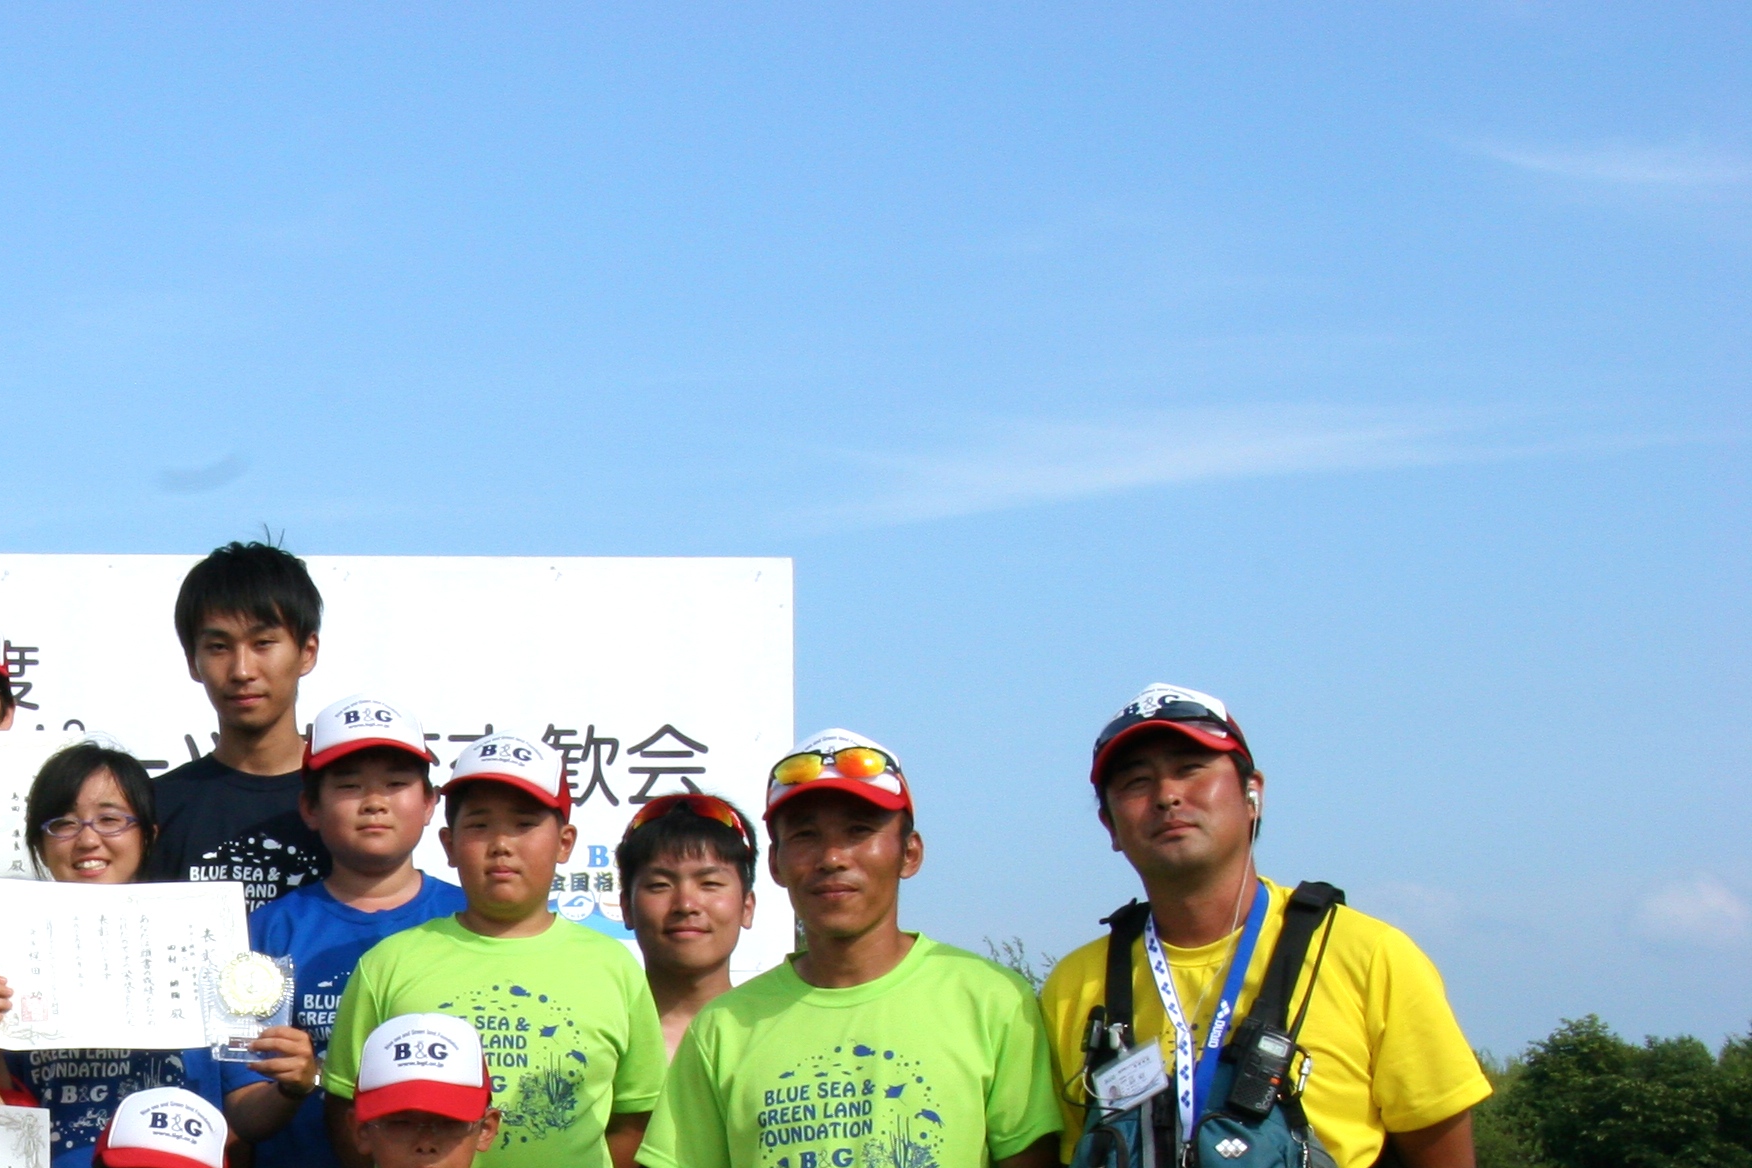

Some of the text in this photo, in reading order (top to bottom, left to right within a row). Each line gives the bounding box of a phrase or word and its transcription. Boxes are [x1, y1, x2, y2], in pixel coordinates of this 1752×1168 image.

[344, 707, 393, 725] B&G
[479, 743, 532, 762] B&G
[189, 866, 281, 881] BLUE SEA &
[550, 871, 622, 893] 全国指
[245, 883, 277, 898] AND
[298, 1011, 336, 1025] GREE
[474, 1015, 531, 1032] SEA &
[1208, 1019, 1226, 1048] arena
[29, 1050, 80, 1066] GREEN
[393, 1040, 448, 1061] B&G
[31, 1061, 131, 1085] FOUNDATION
[60, 1085, 109, 1104] B&G
[764, 1079, 876, 1107] BLUE SEA &
[757, 1099, 873, 1129] GREEN LAND
[149, 1112, 203, 1137] B&G
[759, 1118, 874, 1149] FOUNDATION
